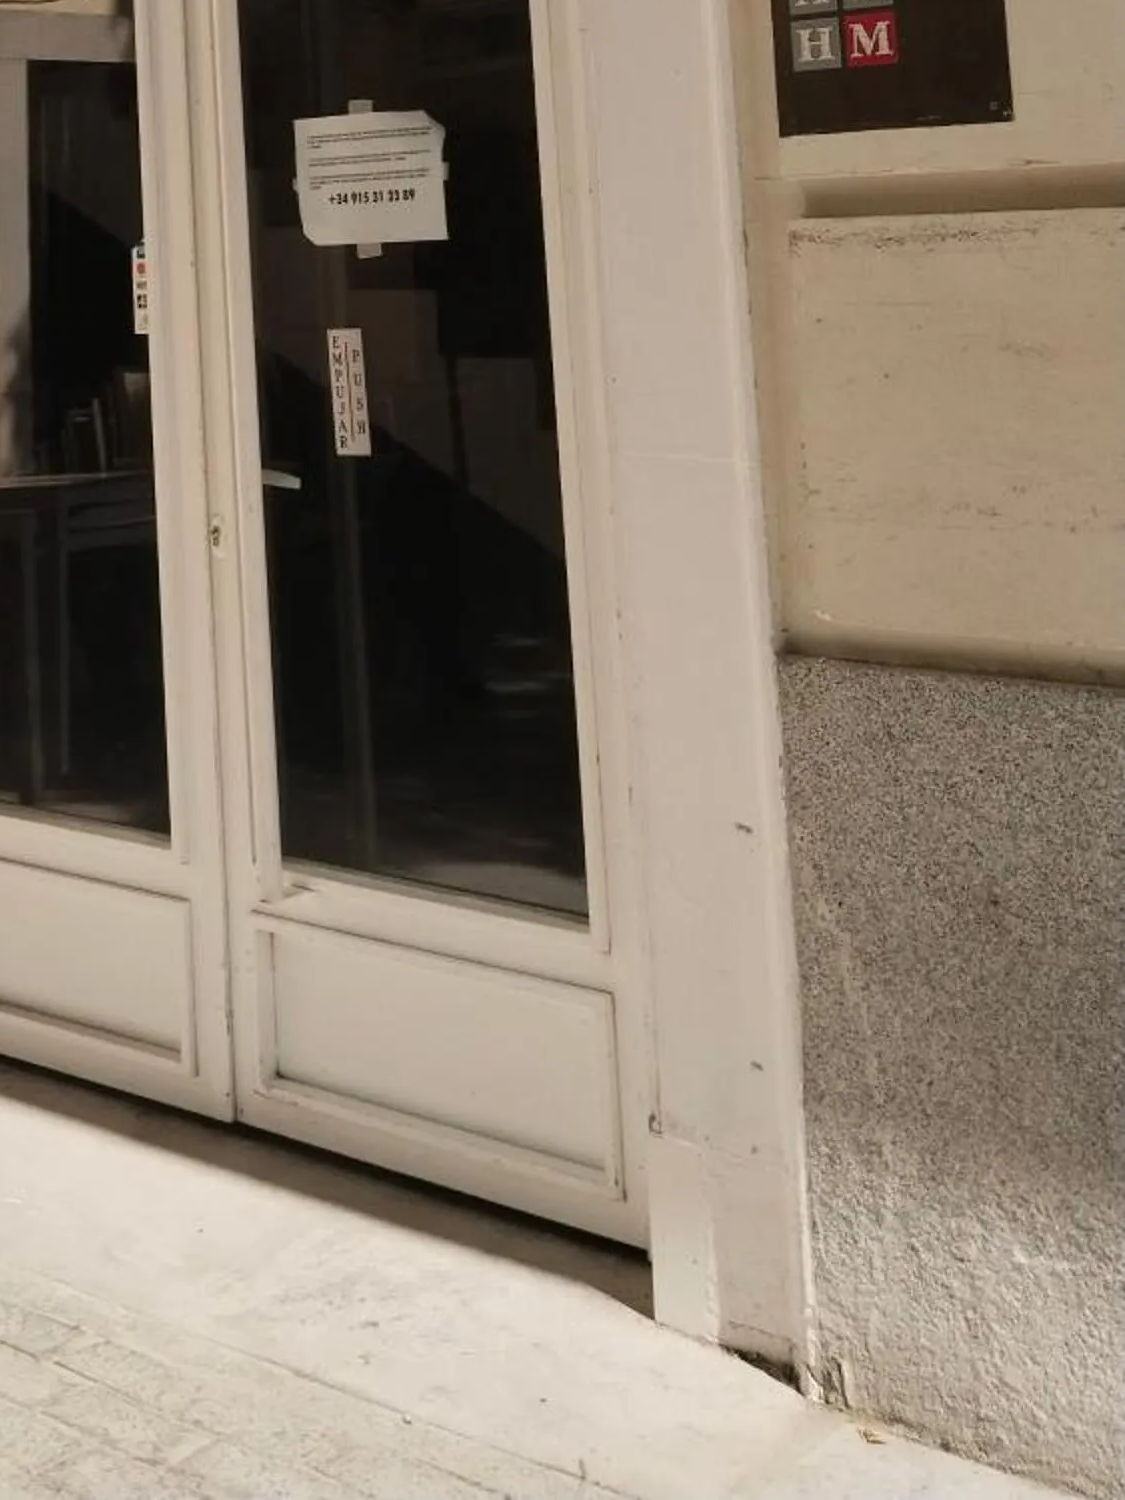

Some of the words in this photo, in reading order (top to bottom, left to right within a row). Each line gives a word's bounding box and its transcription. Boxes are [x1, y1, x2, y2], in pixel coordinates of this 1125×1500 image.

[328, 192, 348, 204] +34
[350, 191, 370, 204] 915
[331, 335, 348, 449] EMPUJAR
[351, 349, 366, 435] PUSH
